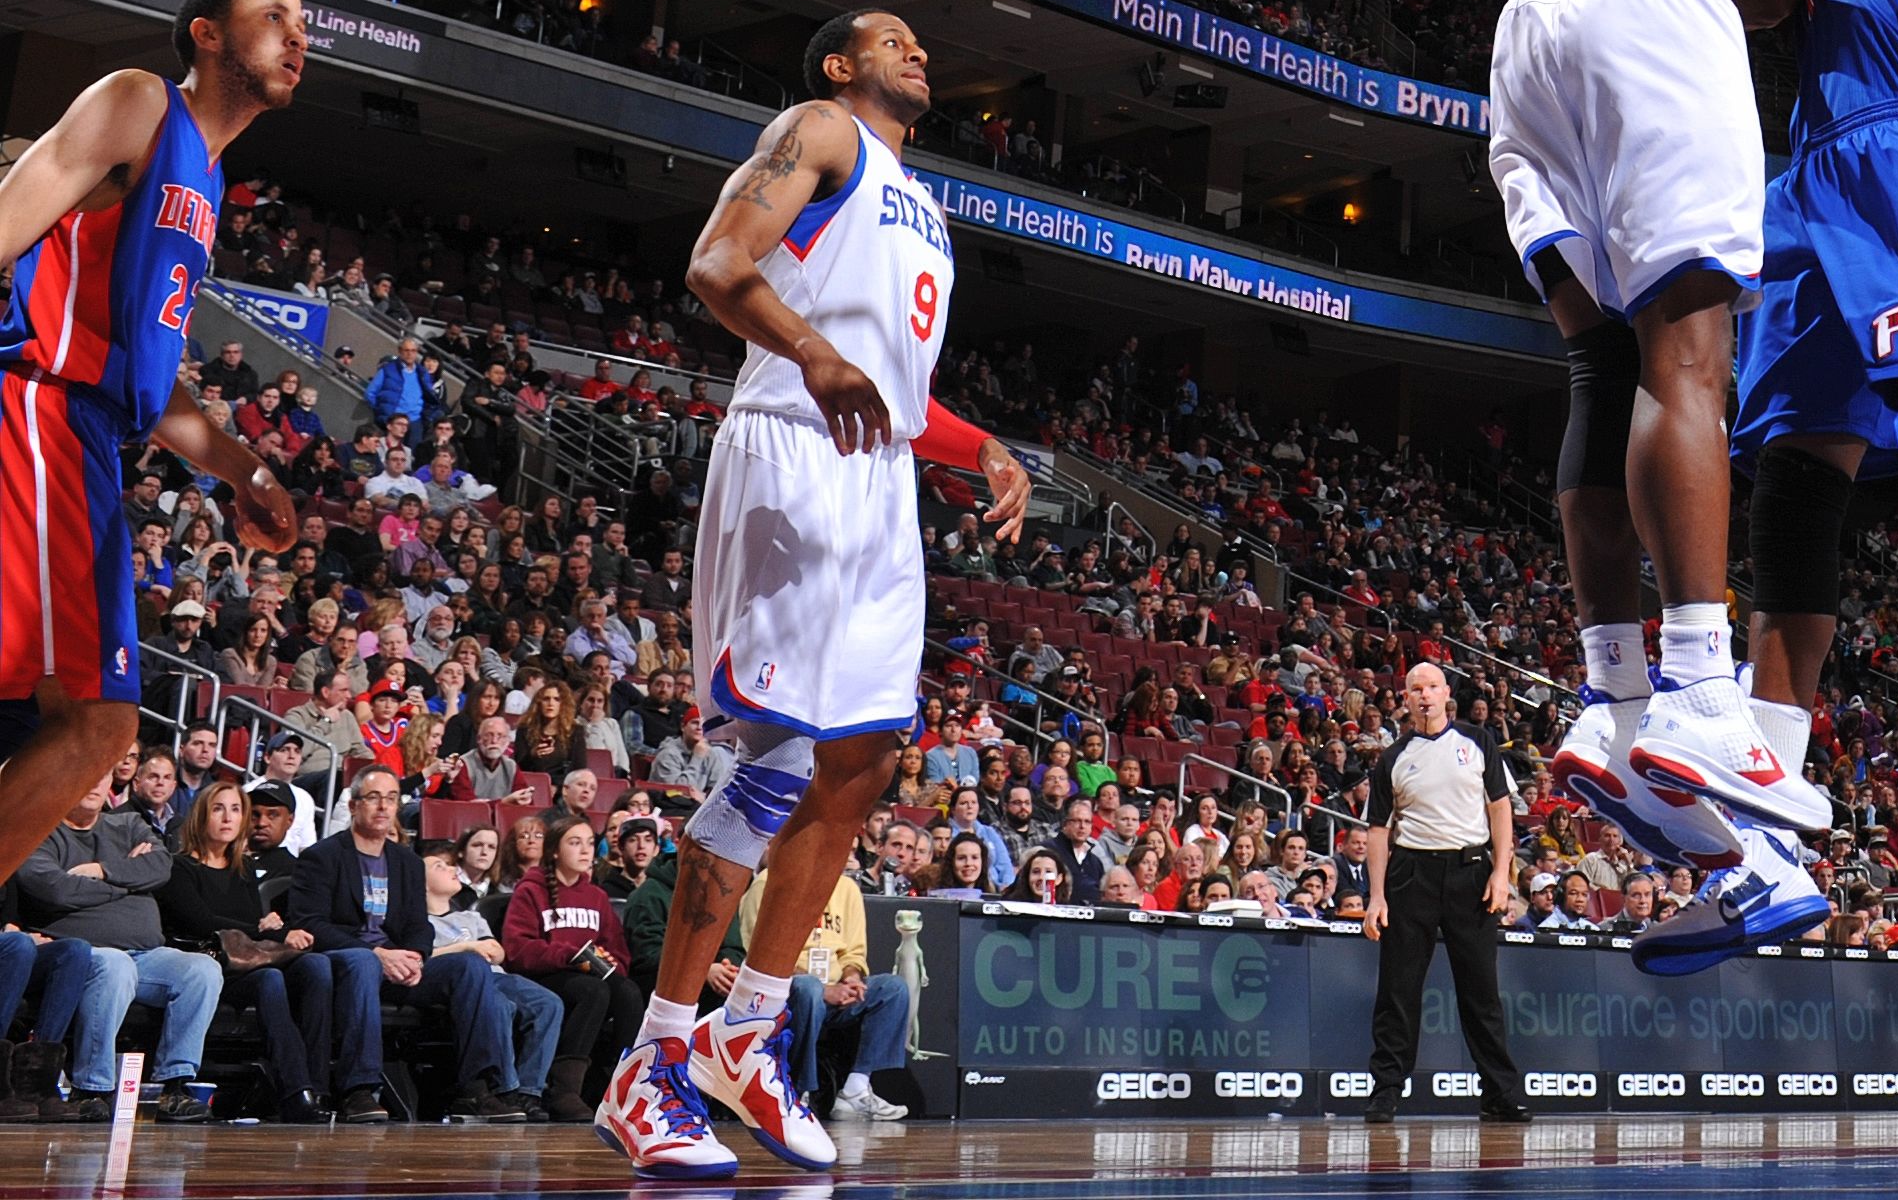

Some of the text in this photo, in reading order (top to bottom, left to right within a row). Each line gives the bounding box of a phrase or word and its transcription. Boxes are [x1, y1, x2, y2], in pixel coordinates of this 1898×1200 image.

[316, 9, 357, 36] Line
[359, 20, 420, 53] Health
[1192, 13, 1251, 65] Line
[1260, 37, 1348, 98] Health
[1357, 70, 1380, 107] is
[1397, 80, 1470, 127] Bryn
[942, 181, 997, 223] Line
[1005, 197, 1087, 248] Health
[1096, 223, 1113, 254] is
[1189, 254, 1252, 295] Mawr
[911, 271, 937, 343] 9
[974, 931, 1200, 1011] CURE
[1500, 991, 1676, 1037] nsurance
[1689, 1000, 1834, 1054] sponsor
[1846, 993, 1877, 1042] of
[974, 1025, 1272, 1058] AUTO INSURANCE
[1097, 1073, 1190, 1099] GEICO
[1215, 1072, 1303, 1098] GEICO
[1433, 1073, 1482, 1097] GEIC
[1525, 1073, 1597, 1097] GEICO
[1618, 1073, 1685, 1097] GEICO
[1701, 1073, 1764, 1097] GEICO
[1778, 1073, 1837, 1096] GEICO
